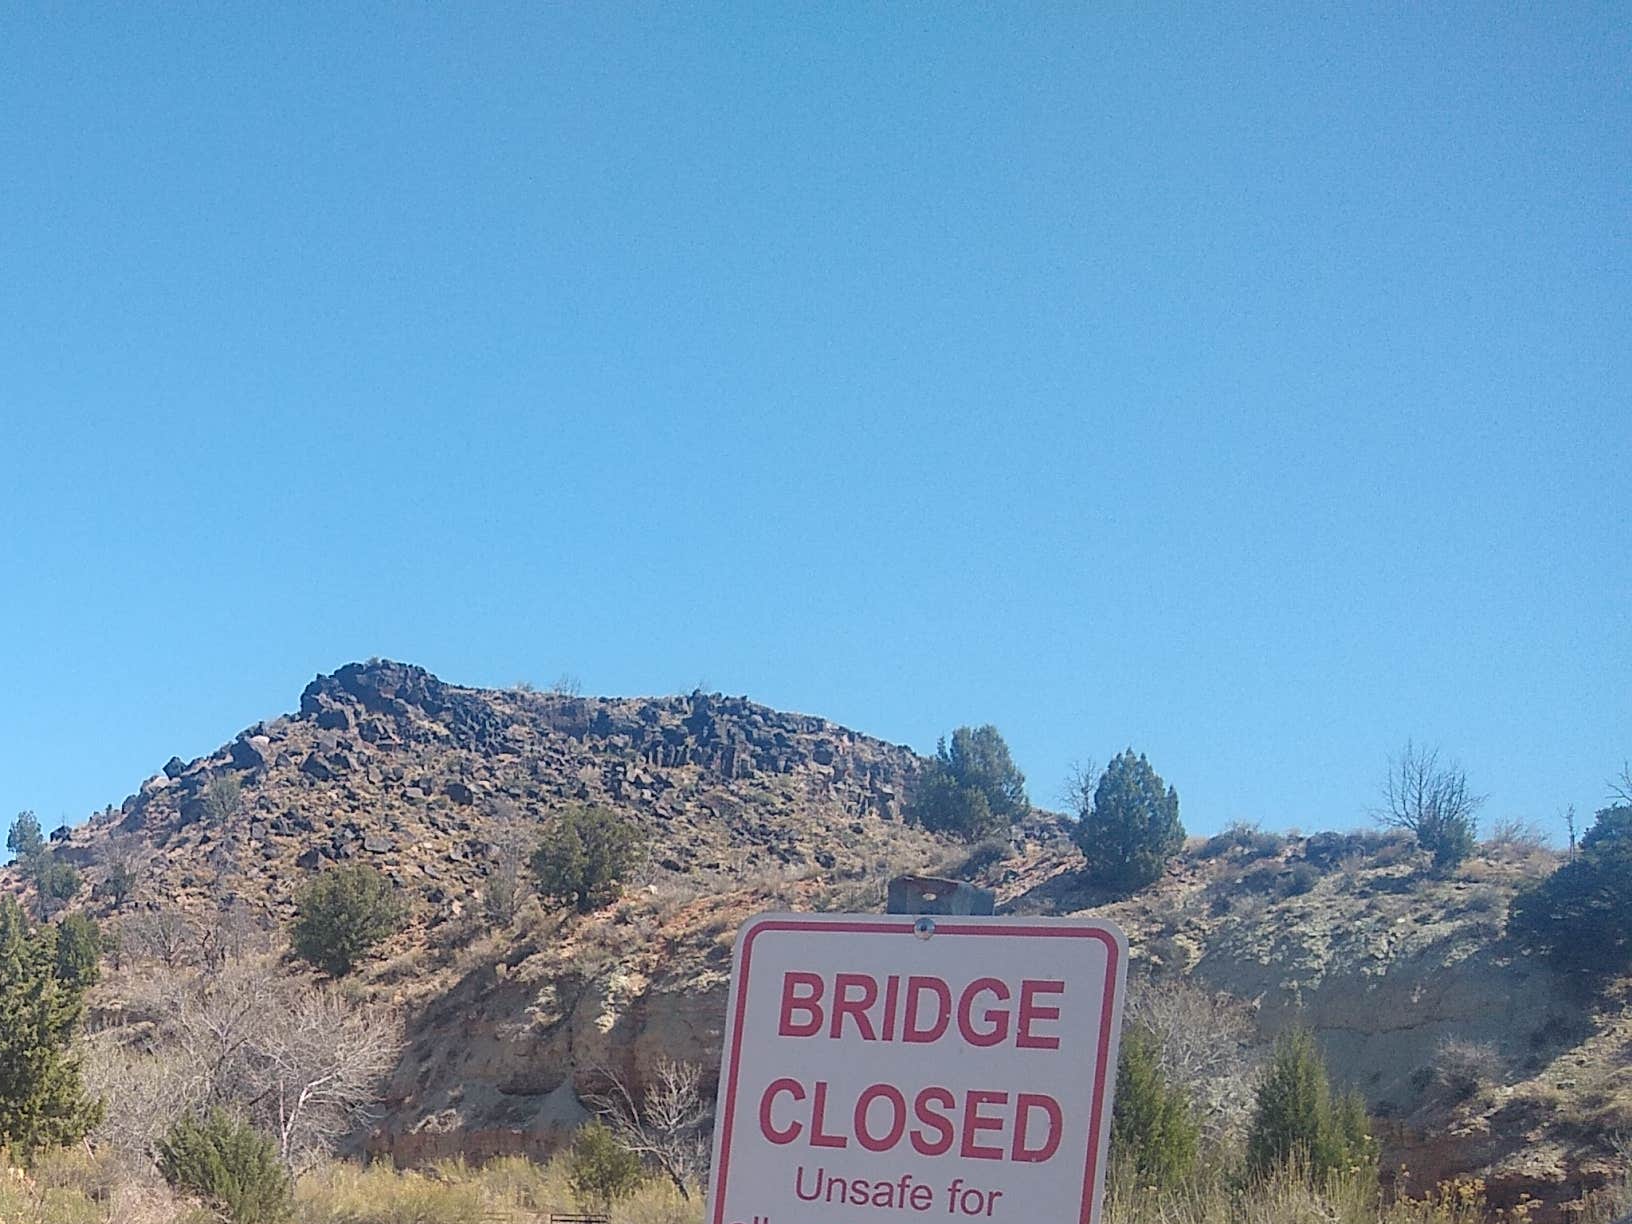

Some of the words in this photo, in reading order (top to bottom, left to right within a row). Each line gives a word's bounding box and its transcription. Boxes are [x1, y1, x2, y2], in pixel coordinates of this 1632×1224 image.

[778, 972, 1066, 1051] BRIDGE
[759, 1078, 1064, 1164] CLOSED
[795, 1166, 933, 1212] Unsafe
[947, 1178, 1003, 1217] for
